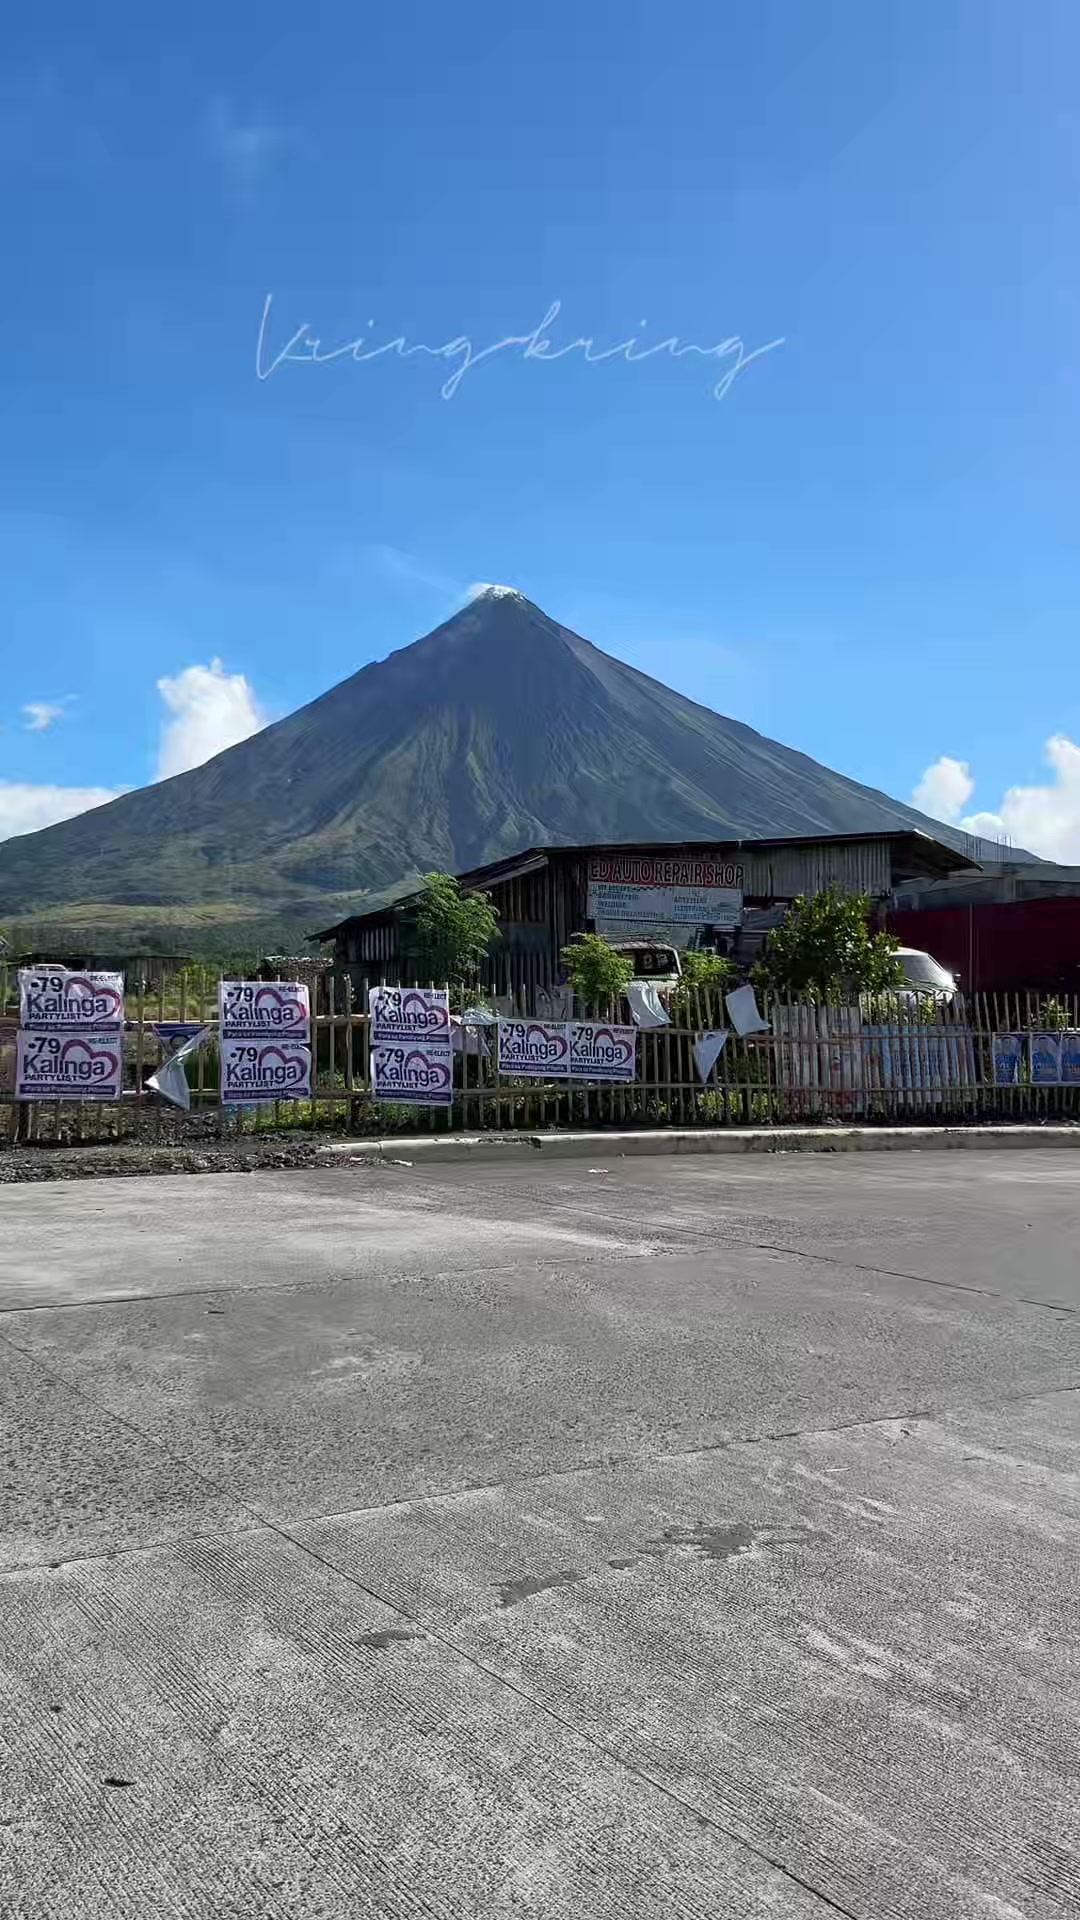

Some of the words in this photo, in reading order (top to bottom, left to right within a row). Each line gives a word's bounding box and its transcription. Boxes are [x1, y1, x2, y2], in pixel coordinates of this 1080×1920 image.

[612, 859, 652, 882] AUTO
[653, 861, 704, 886] REPAIR
[704, 862, 744, 888] SHOP
[27, 993, 108, 1018] Kalinga
[28, 1012, 84, 1020] PARTYLIST
[223, 1003, 294, 1025] Kalinga
[374, 1005, 439, 1029] Kalinga
[376, 1023, 417, 1031] PARTYLIST
[499, 1037, 558, 1060] Kalinga
[500, 1053, 540, 1061] PARTYLIST
[569, 1040, 623, 1062] Kalinga
[23, 1054, 105, 1080] Kalinga
[570, 1056, 604, 1065] PARTYLIST
[226, 1063, 297, 1084] Kalinga
[227, 1080, 274, 1088] PARTYLIST
[375, 1063, 440, 1087] Kalinga
[376, 1081, 419, 1089] PARTYLIST
